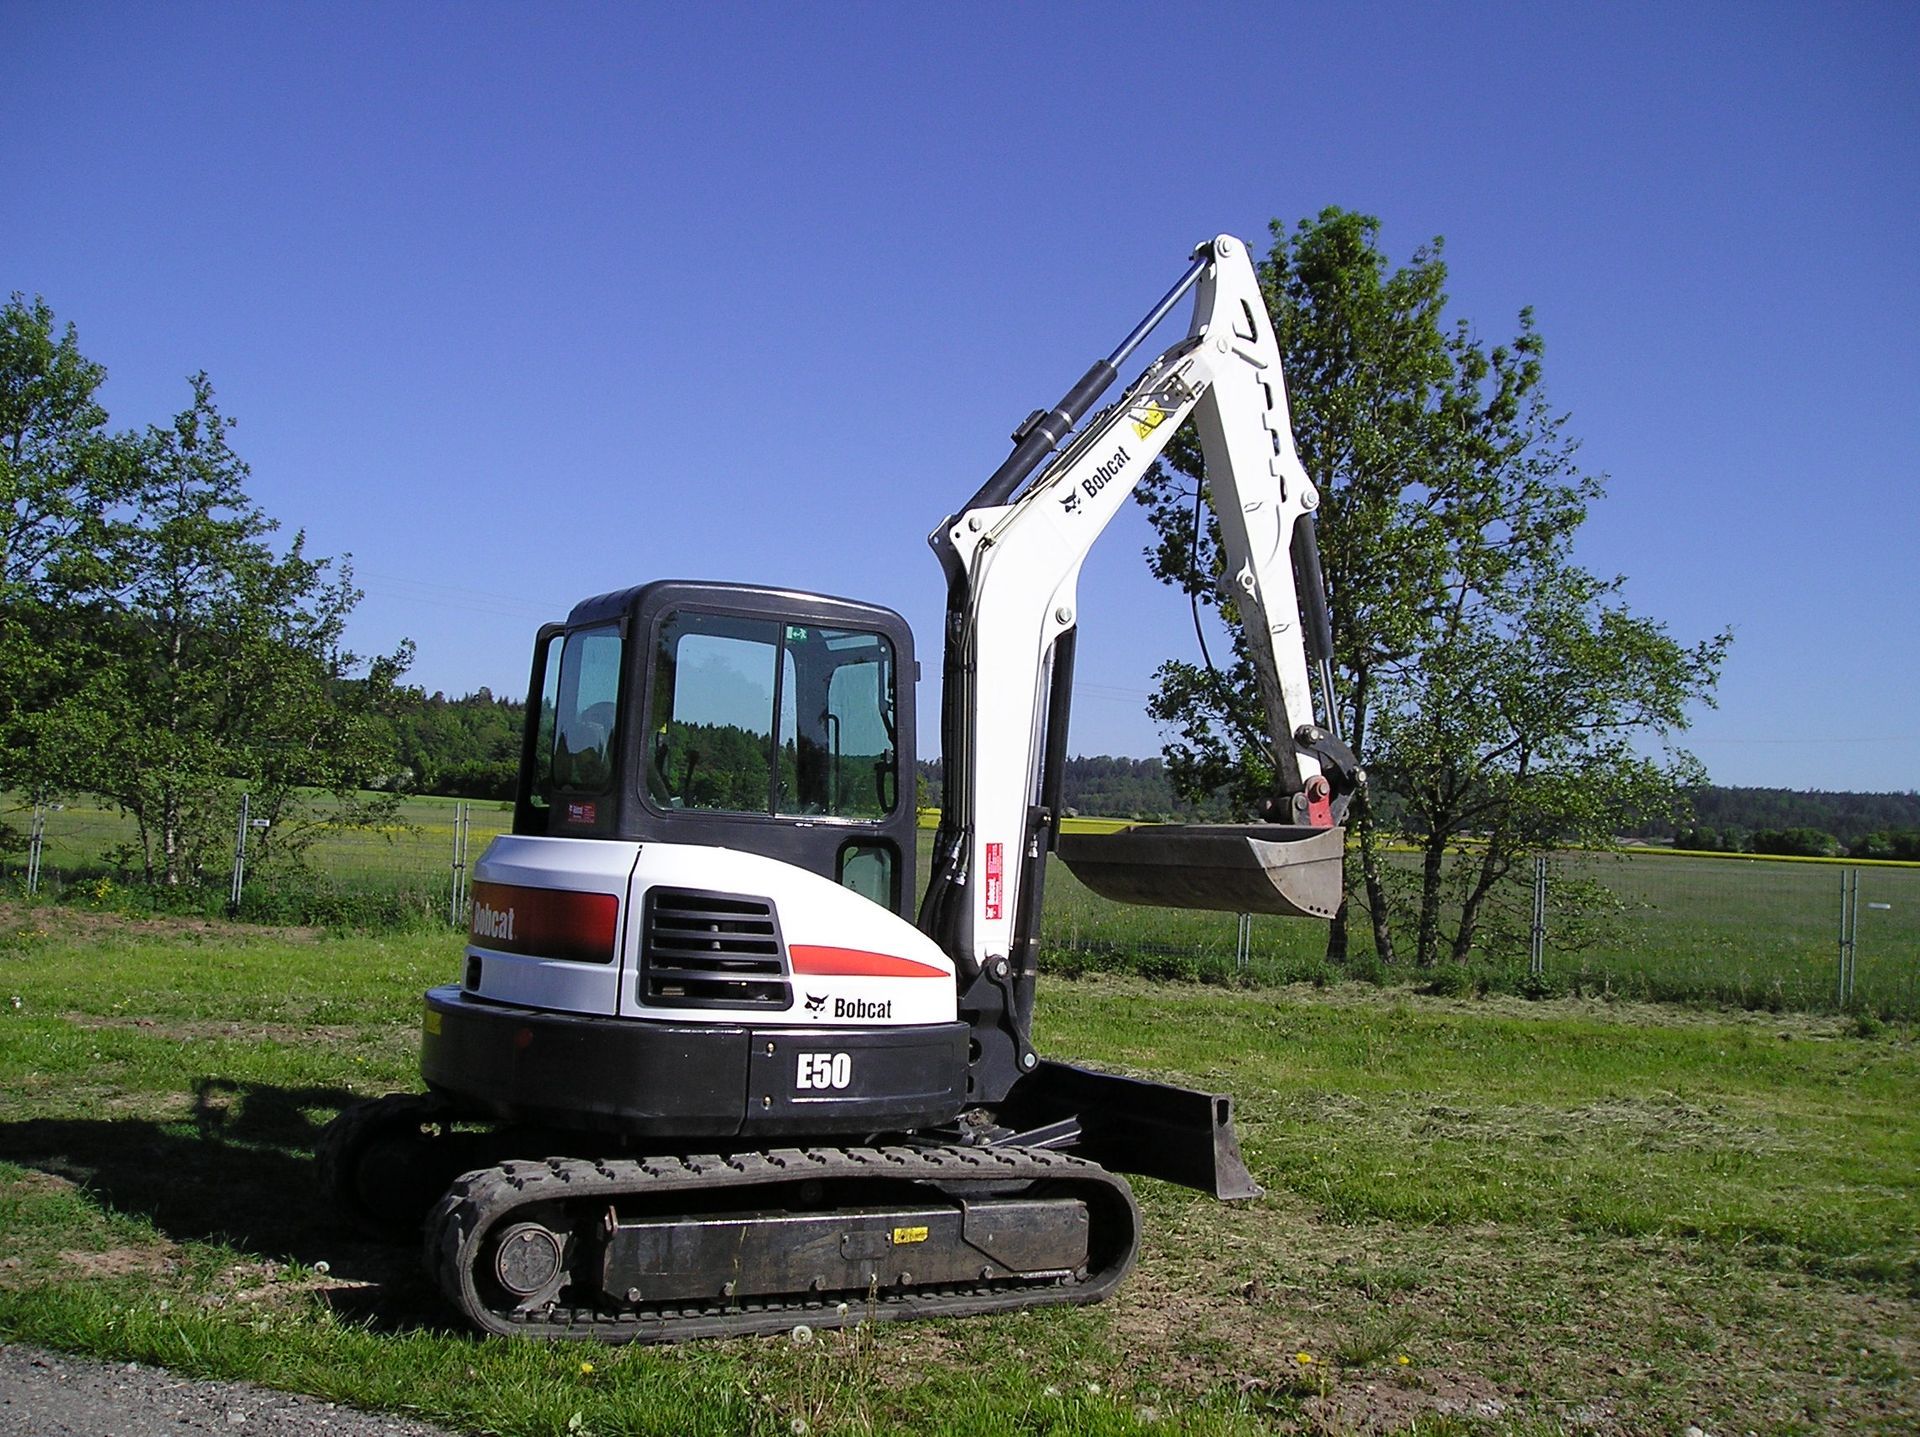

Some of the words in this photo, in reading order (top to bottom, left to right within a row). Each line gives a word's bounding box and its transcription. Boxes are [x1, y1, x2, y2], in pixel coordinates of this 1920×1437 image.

[1081, 446, 1131, 498] Bobcat
[834, 998, 891, 1018] Bobcat
[796, 1053, 851, 1089] E50
